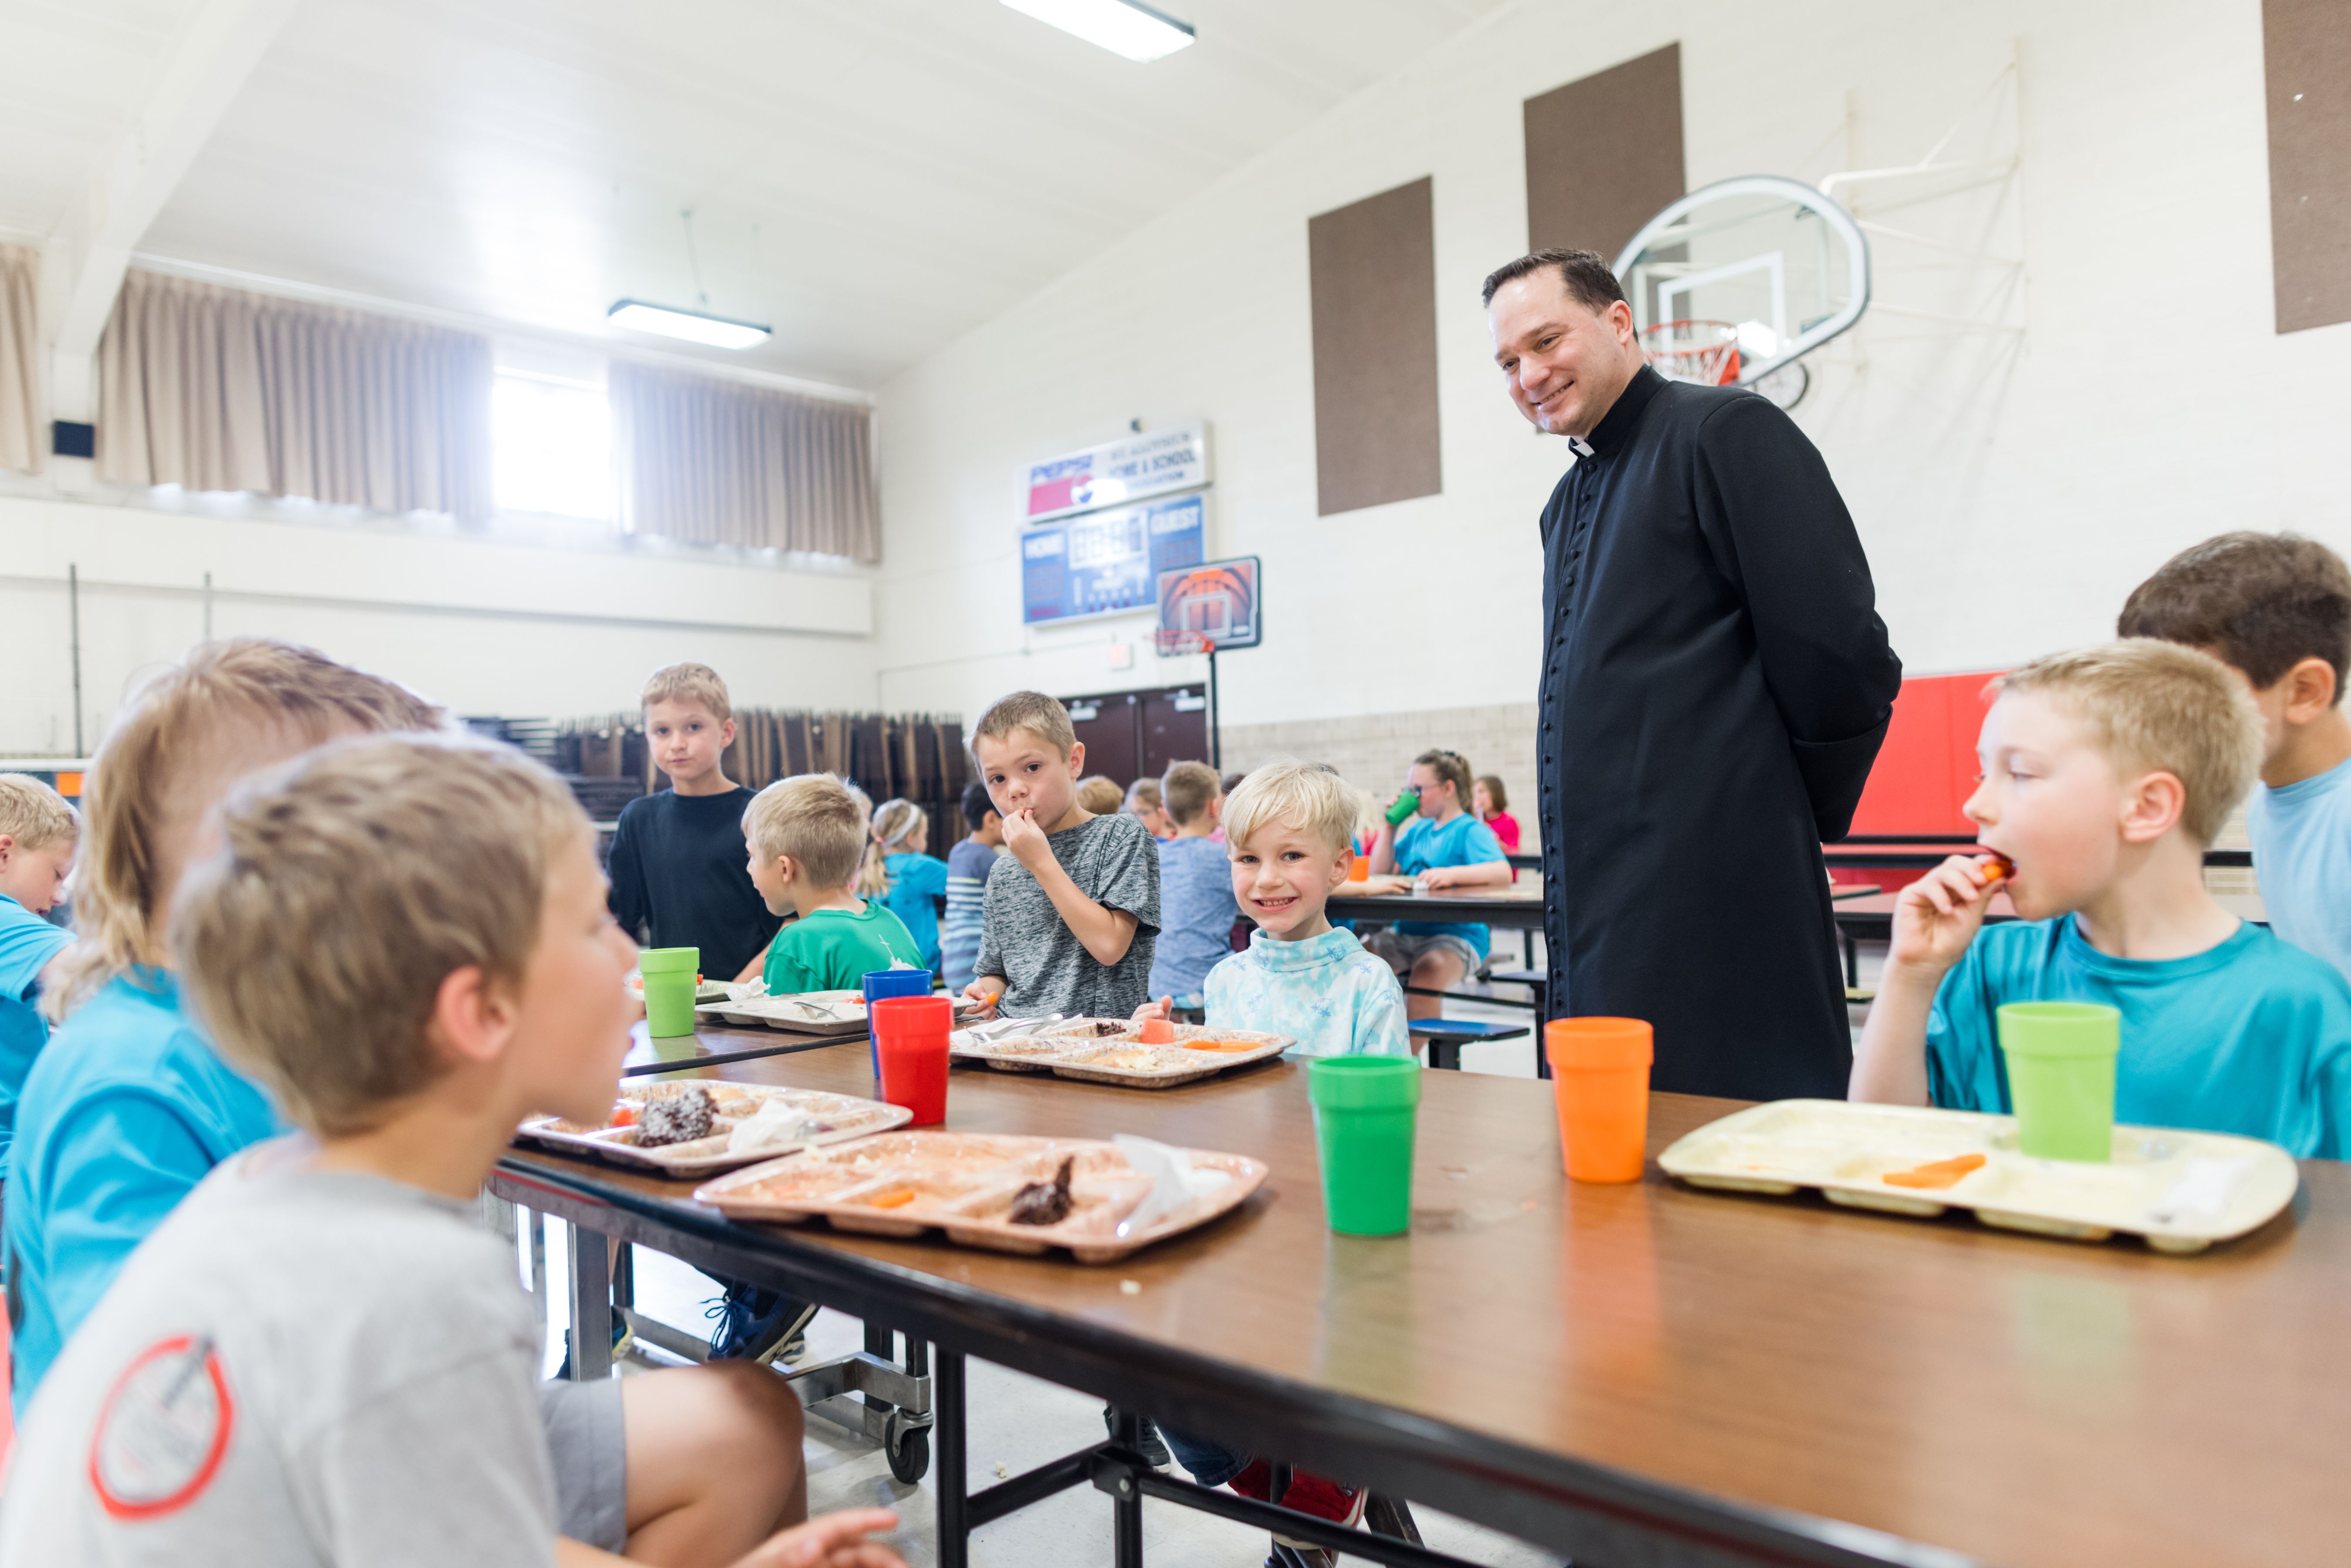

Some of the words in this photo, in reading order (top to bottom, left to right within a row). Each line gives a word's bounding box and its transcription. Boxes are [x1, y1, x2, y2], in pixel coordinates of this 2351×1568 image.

[1031, 454, 1094, 483] PEPSI
[1153, 448, 1196, 470] SCHOOL
[1150, 506, 1199, 535] GUEST
[1024, 533, 1065, 559] HOME
